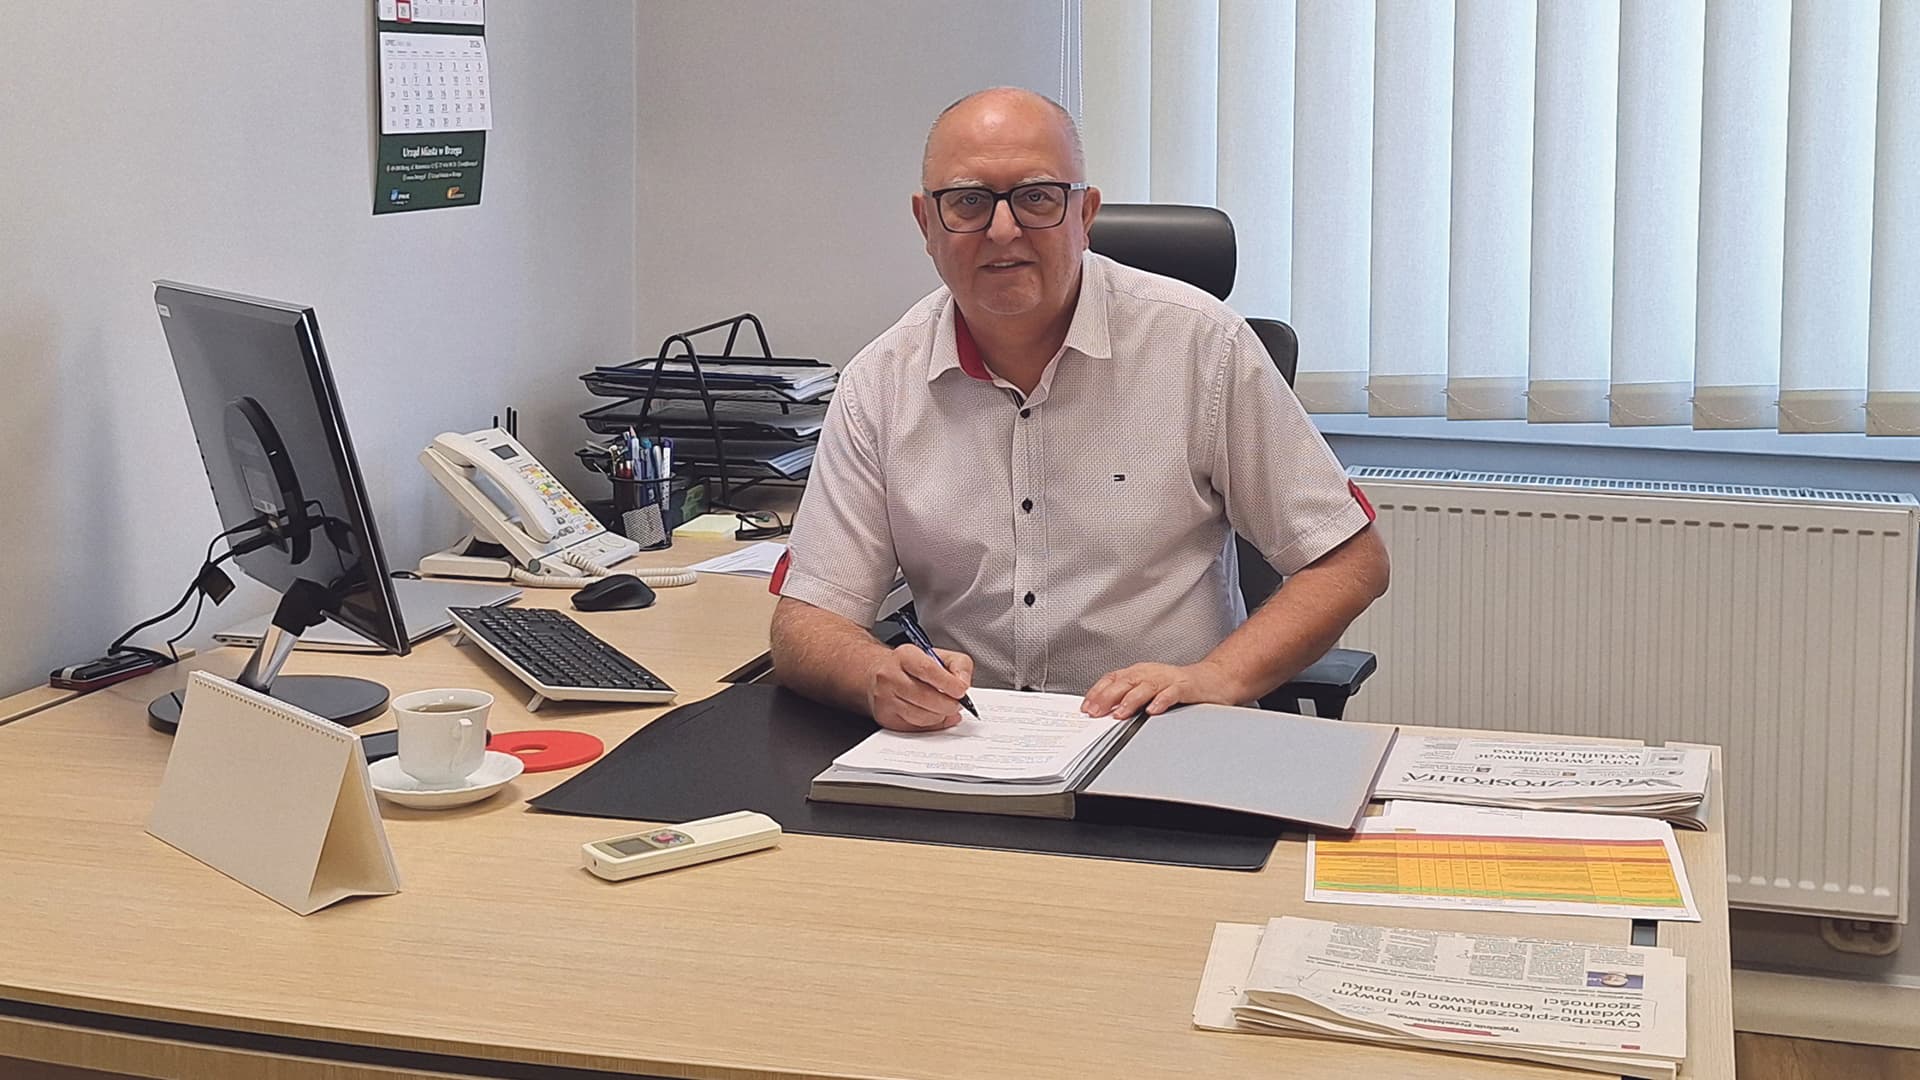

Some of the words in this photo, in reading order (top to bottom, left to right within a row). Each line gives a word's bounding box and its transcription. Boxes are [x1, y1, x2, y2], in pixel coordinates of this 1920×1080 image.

[1332, 987, 1398, 1005] nowym
[1342, 982, 1393, 996] braku
[1400, 990, 1533, 1012] konsekwencje
[1543, 998, 1642, 1010] zgodności
[1429, 1002, 1641, 1029] Cyberbezpieczeństwo
[1561, 1007, 1641, 1019] wydaniu
